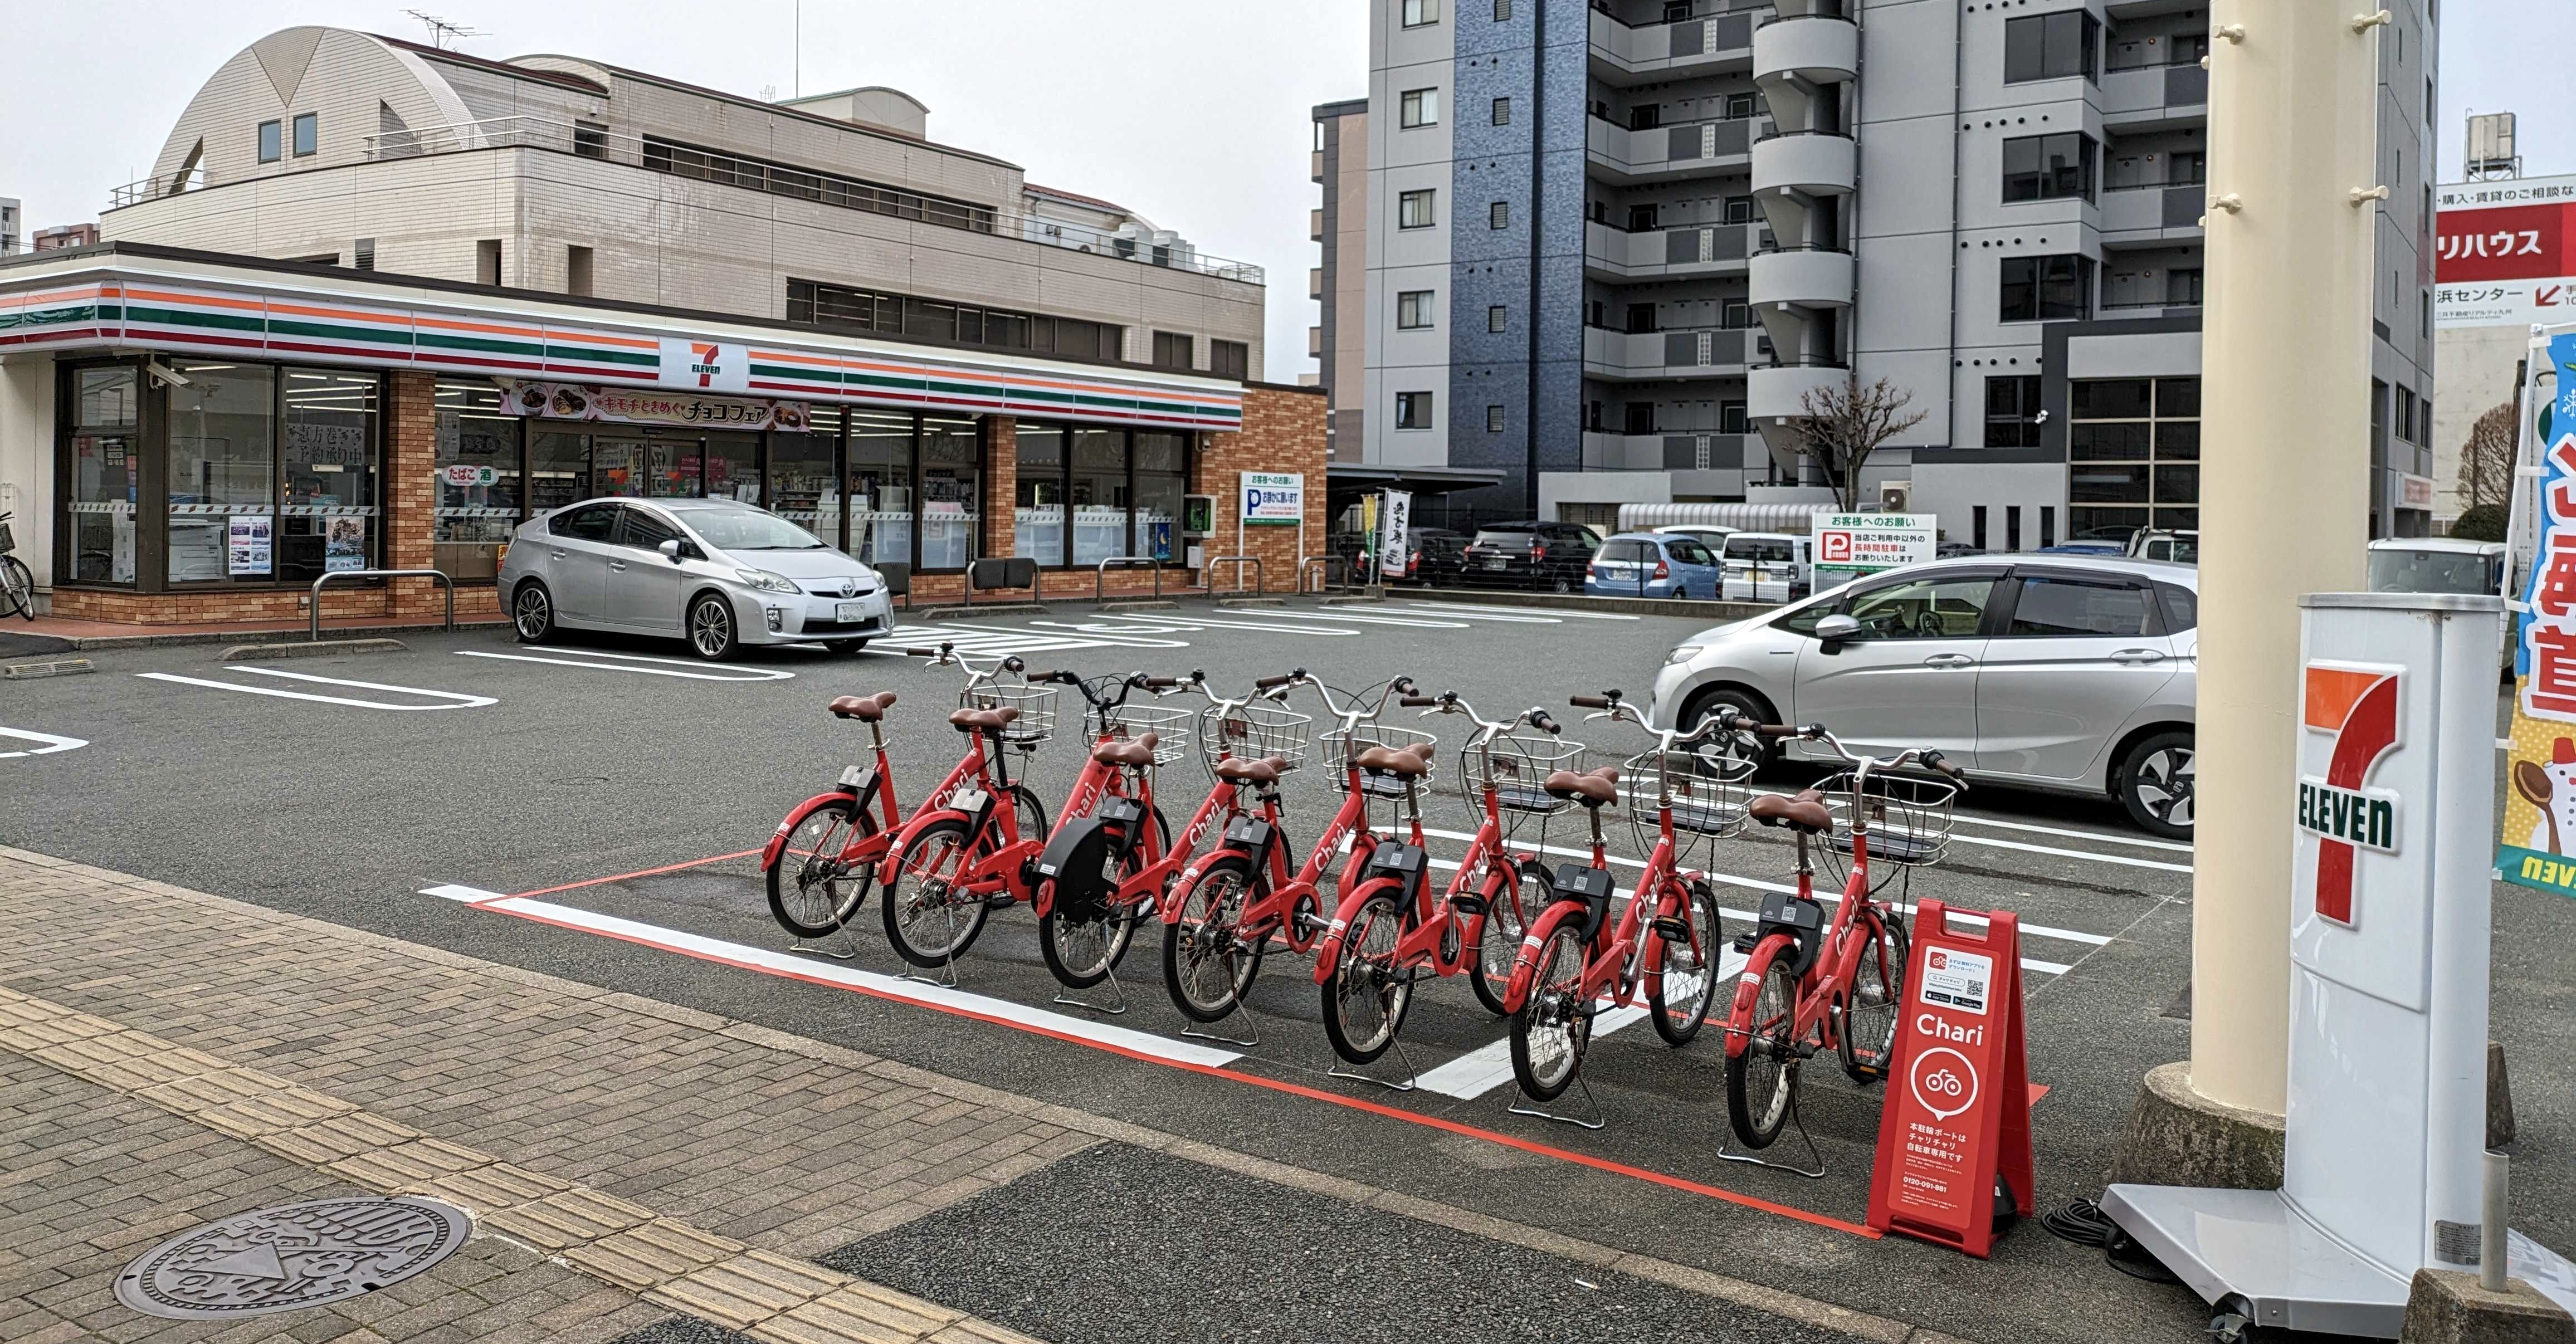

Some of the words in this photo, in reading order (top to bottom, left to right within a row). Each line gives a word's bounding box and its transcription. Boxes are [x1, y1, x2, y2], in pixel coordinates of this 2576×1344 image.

[2437, 230, 2542, 260] リハウス
[2437, 287, 2523, 304] 浜センター
[691, 343, 719, 387] 7
[604, 396, 680, 415] キモチときめく
[681, 400, 768, 422] チョコフェア
[449, 468, 475, 480] たばこ
[480, 469, 491, 481] 酒
[1252, 475, 1294, 485] お客様へのお願い
[1247, 488, 1261, 516] P
[1832, 516, 1915, 527] お客様へのお願い
[1855, 534, 1925, 542] 当店ご利用中以外の
[1855, 544, 1906, 552] 長時間駐車は
[1855, 554, 1914, 563] お断りいたします
[934, 768, 969, 812] Chari
[2304, 667, 2398, 924] 7
[1189, 798, 1221, 846] Chari
[1315, 822, 1346, 872] Chari
[1460, 842, 1489, 892] Chari
[1636, 866, 1662, 923] Chari
[1836, 895, 1858, 957] Chari
[1917, 1014, 1983, 1046] Chari
[1909, 1122, 1966, 1142] 本駐輪ポートは
[1909, 1133, 1955, 1150] チャリチャリ
[1907, 1142, 1963, 1162] 自転車専用です
[1903, 1176, 1947, 1193] 0120-091-881
